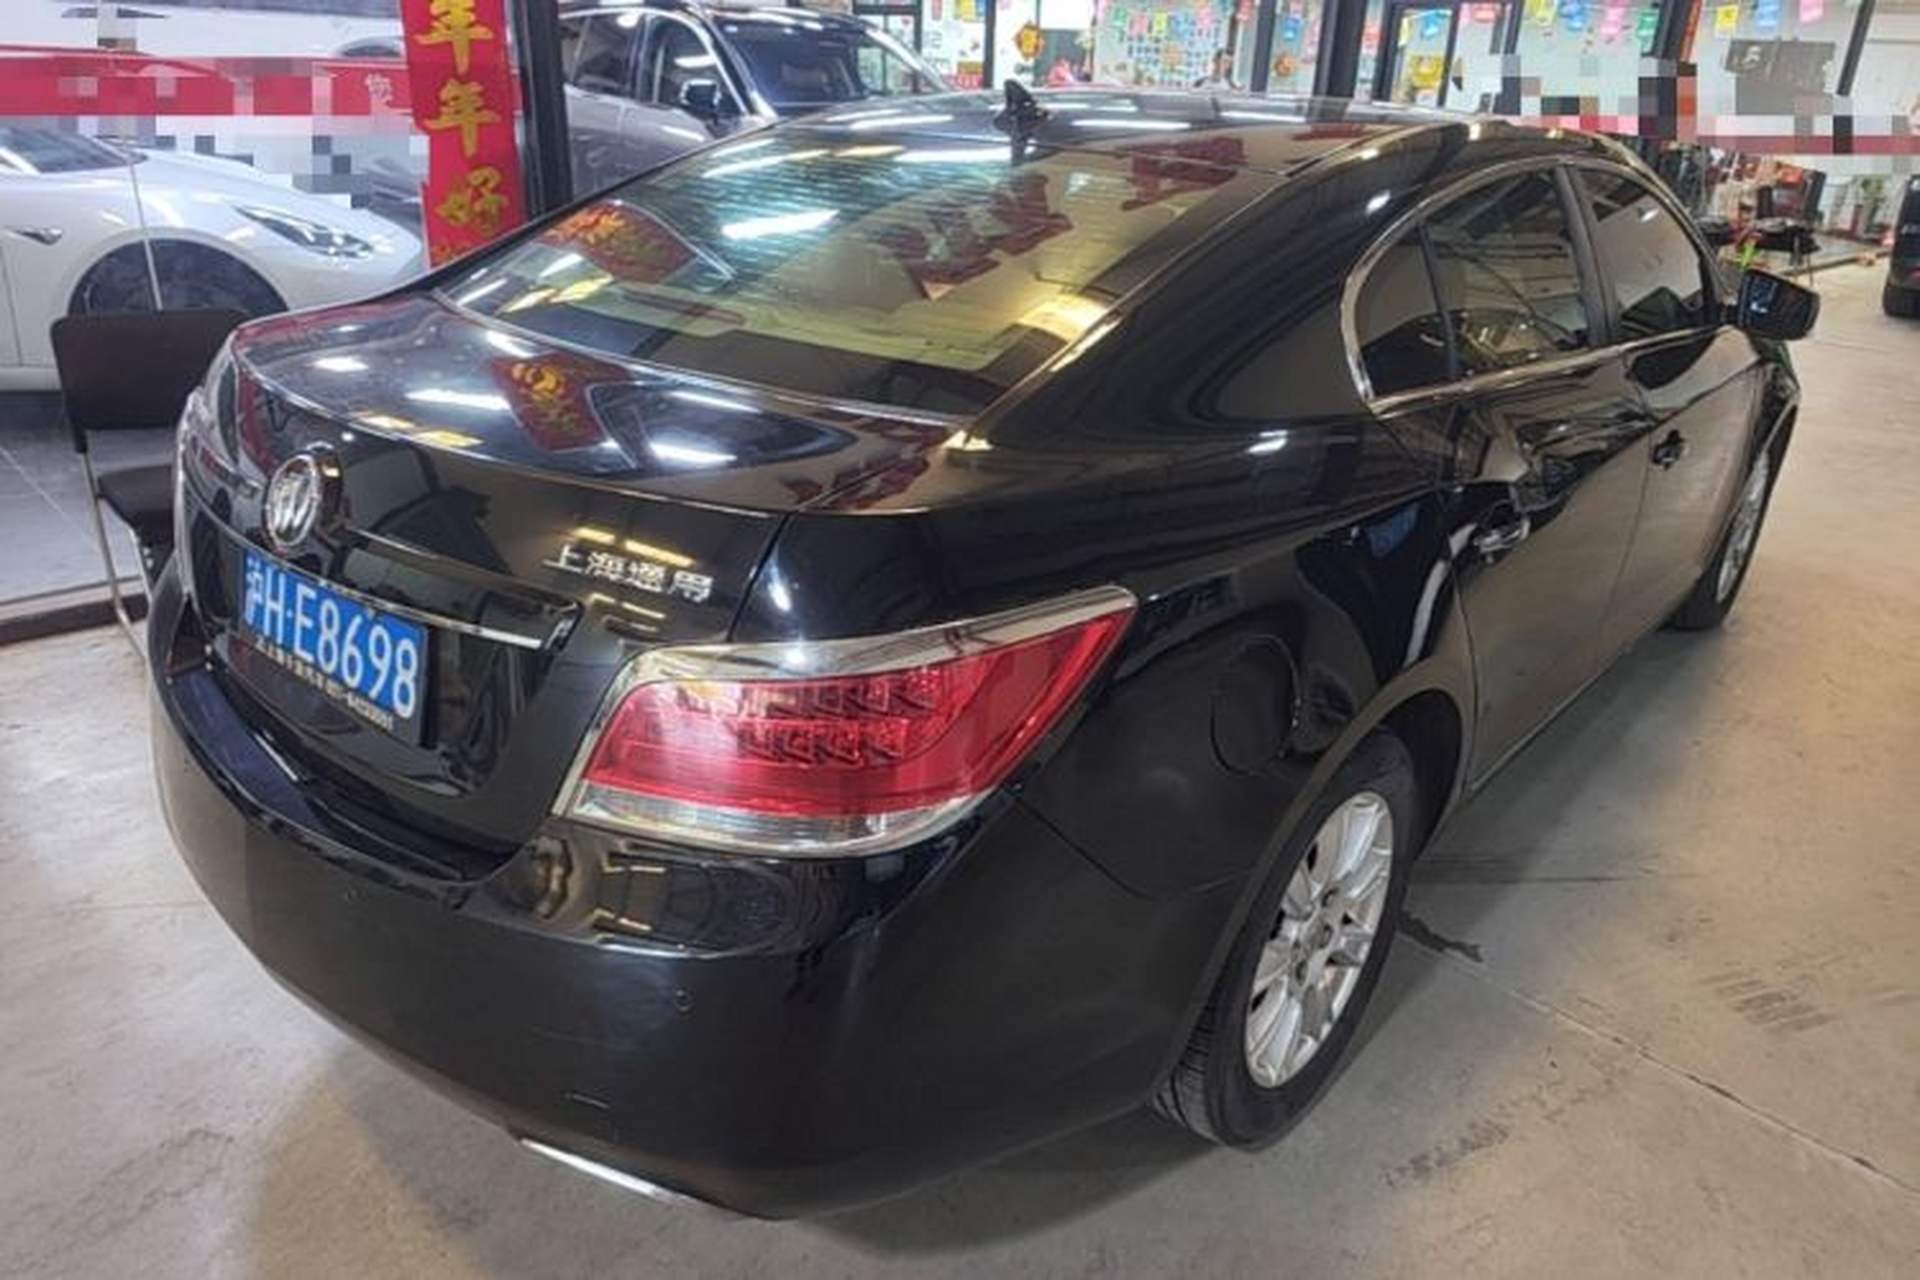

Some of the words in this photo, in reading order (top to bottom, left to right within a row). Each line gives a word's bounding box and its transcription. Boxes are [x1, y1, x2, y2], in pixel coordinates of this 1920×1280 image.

[413, 0, 508, 262] 年年好
[542, 544, 713, 603] 上海通用
